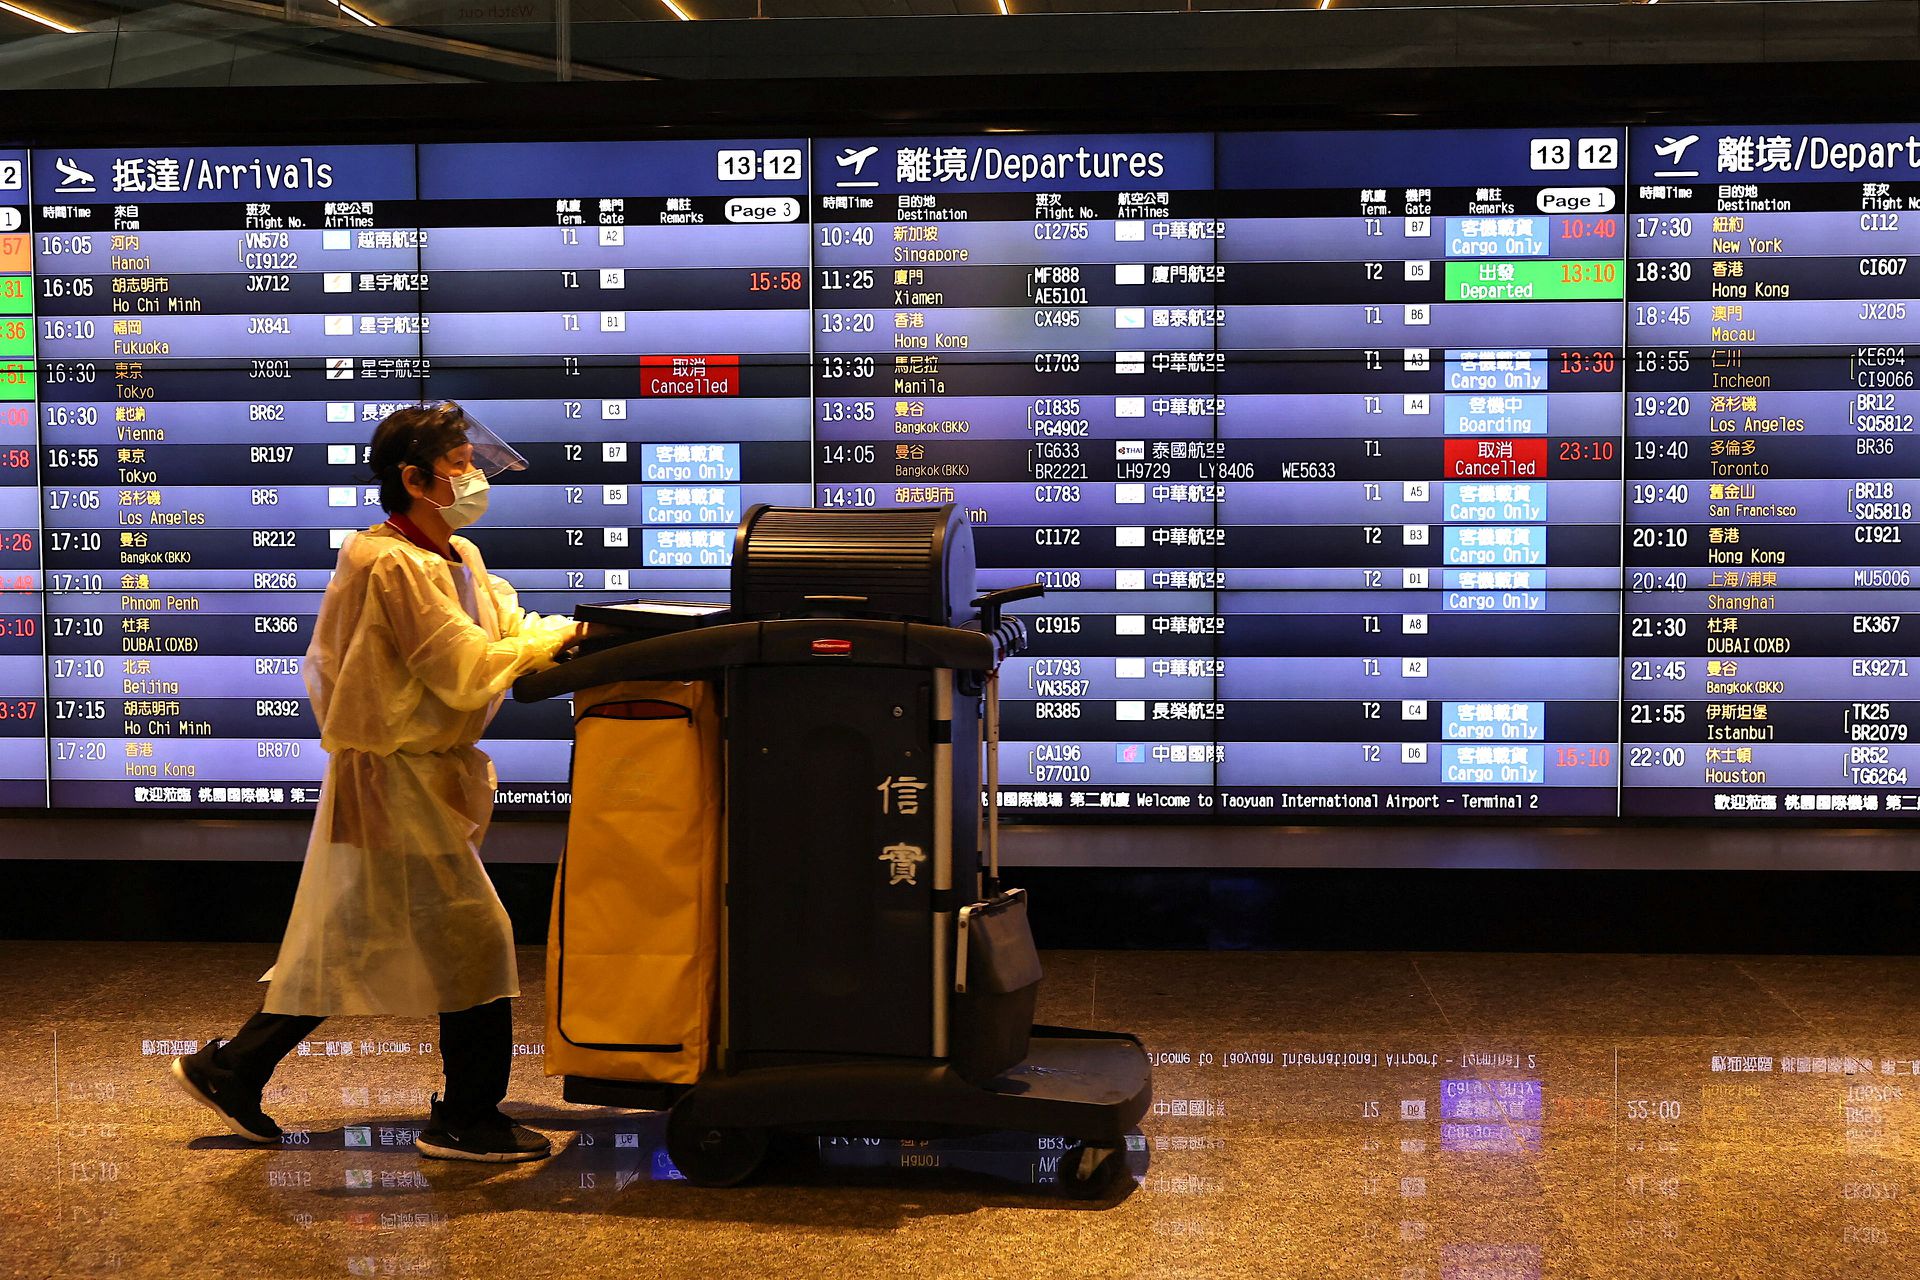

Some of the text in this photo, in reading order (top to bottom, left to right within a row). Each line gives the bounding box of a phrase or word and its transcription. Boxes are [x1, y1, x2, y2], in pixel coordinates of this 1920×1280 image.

[1538, 145, 1610, 164] 13 12
[1544, 193, 1605, 210] Page 1
[557, 213, 585, 224] Term.
[599, 210, 624, 224] Gate
[661, 212, 703, 223] Remarks
[732, 203, 790, 219] Page 3
[898, 208, 968, 220] Destination
[115, 218, 139, 230] From
[246, 217, 305, 229] Flight No.
[325, 216, 373, 227] Airlines
[1637, 217, 1691, 237] 17:30
[1861, 213, 1898, 230] CI12
[246, 230, 288, 248] VN578
[561, 229, 578, 244] T1
[607, 231, 617, 241] A2
[822, 227, 873, 246] 10:40
[1034, 223, 1088, 239] CI2755
[43, 236, 91, 254] 16:05
[1714, 238, 1782, 253] New York
[112, 256, 149, 269] Hanoi
[895, 247, 968, 262] Singapore
[1035, 267, 1079, 283] MF888
[1412, 265, 1423, 275] D5
[1637, 262, 1690, 281] 18:30
[247, 275, 289, 291] JX712
[751, 272, 801, 290] 15:58
[822, 270, 873, 289] 11:25
[895, 290, 942, 304] Xiamen
[1461, 282, 1533, 299] Departed
[114, 298, 200, 312] Ho Chi Minh
[1859, 302, 1905, 319] JX205
[608, 317, 618, 327] B1
[822, 312, 873, 332] 13:20
[1636, 306, 1690, 325] 18:45
[45, 320, 94, 338] 16:10
[1712, 327, 1754, 341] Macau
[115, 340, 168, 354] Fukuoka
[895, 333, 967, 348] Hong Kong
[117, 385, 154, 399] Tokyo
[652, 379, 727, 393] Cancelled
[895, 379, 944, 393] Manila
[250, 403, 284, 420] BR62
[564, 402, 581, 418] T2
[823, 402, 874, 420] 13:35
[1635, 397, 1689, 416] 19:20
[48, 407, 97, 425] 16:30
[1857, 415, 1913, 431] SQ5812
[118, 426, 163, 440] Vienna
[49, 449, 98, 467] 16:55
[251, 447, 293, 462] BR197
[824, 446, 874, 463] 14:05
[1036, 443, 1079, 458] TG633
[1560, 442, 1612, 460] 23:10
[1635, 441, 1687, 459] 19:40
[648, 464, 733, 480] Cargo Only
[1036, 464, 1088, 479] BR2221
[1118, 463, 1170, 478] LH9729
[1282, 463, 1335, 478] WE5633
[1711, 461, 1768, 475] Toronto
[51, 489, 99, 509] 17:05
[250, 489, 279, 505] BR5
[824, 488, 875, 506] 14:10
[1036, 486, 1080, 502] CI783
[120, 511, 204, 525] Los Angeles
[649, 507, 734, 523] Cargo Only
[1710, 505, 1796, 516] San Francisco
[1856, 503, 1911, 519] SQ5818
[52, 533, 100, 550] 17:10
[253, 531, 295, 546] BR212
[611, 532, 622, 542] B4
[1634, 529, 1687, 547] 20:10
[1855, 526, 1901, 542] CI921
[611, 575, 622, 584] C1
[122, 596, 198, 610] Phnom Penh
[1709, 595, 1774, 610] Shanghai
[1036, 617, 1080, 633] CI915
[1632, 618, 1686, 636] 21:30
[1632, 661, 1685, 680] 21:45
[1853, 657, 1908, 676] EK9271
[124, 679, 178, 694] Beijing
[57, 701, 105, 718] 17:15
[1631, 705, 1685, 723] 21:55
[1853, 704, 1889, 719] TK25
[1708, 725, 1773, 739] Istanbul
[1852, 725, 1907, 740] BR2079
[58, 741, 105, 759] 17:20
[258, 741, 302, 757] BR870
[1037, 744, 1080, 761] CA196
[1631, 746, 1686, 766] 22:00
[126, 762, 194, 776] Hong Kong
[1037, 765, 1089, 781] B77010
[1706, 768, 1765, 783] Houston
[1851, 768, 1907, 784] TG6264
[1137, 793, 1190, 806] Welcome
[1198, 794, 1213, 806] to
[1221, 794, 1273, 808] Taoyuan
[1282, 794, 1377, 807] International
[1386, 794, 1439, 809] Airport
[1462, 794, 1521, 808] Terminal
[1530, 795, 1538, 808] 2
